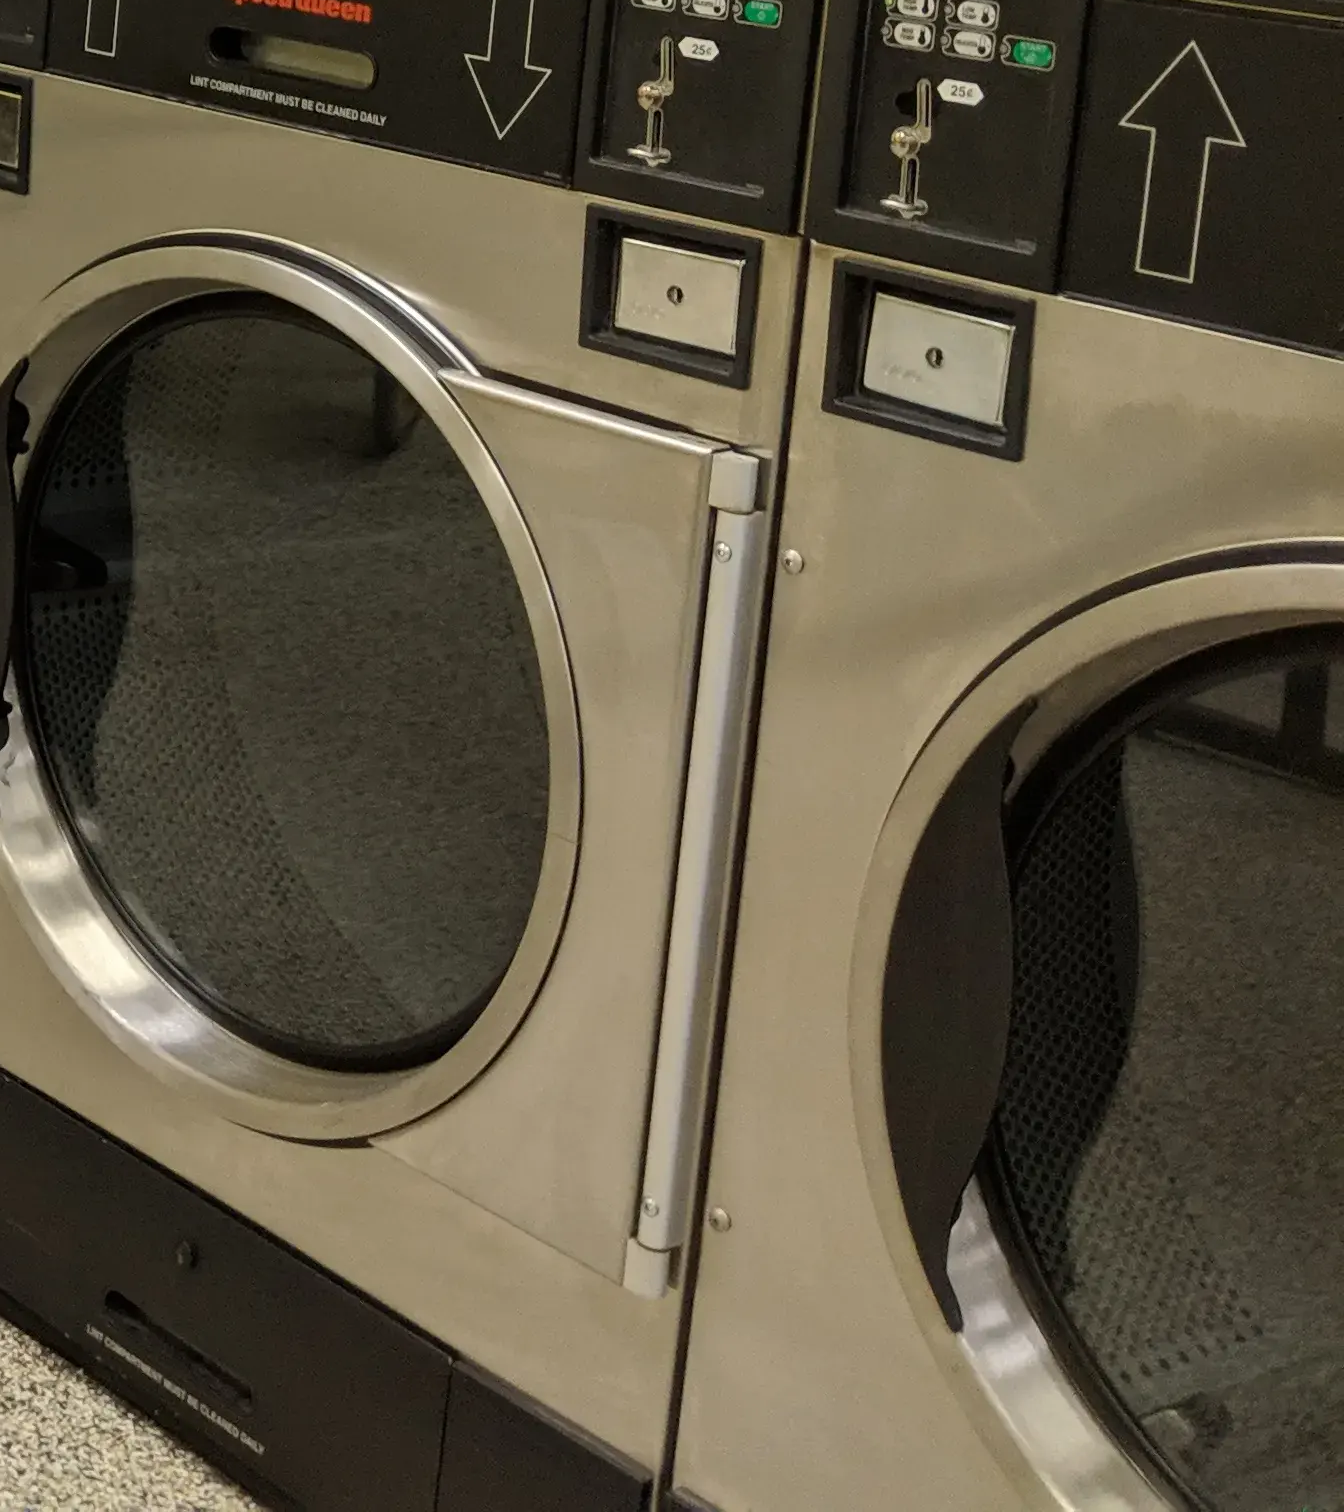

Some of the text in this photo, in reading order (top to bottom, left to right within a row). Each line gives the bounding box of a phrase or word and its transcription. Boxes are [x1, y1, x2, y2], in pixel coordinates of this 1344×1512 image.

[189, 74, 387, 126] LINT COMPARTMENT MUST BE CLEANED DAILY
